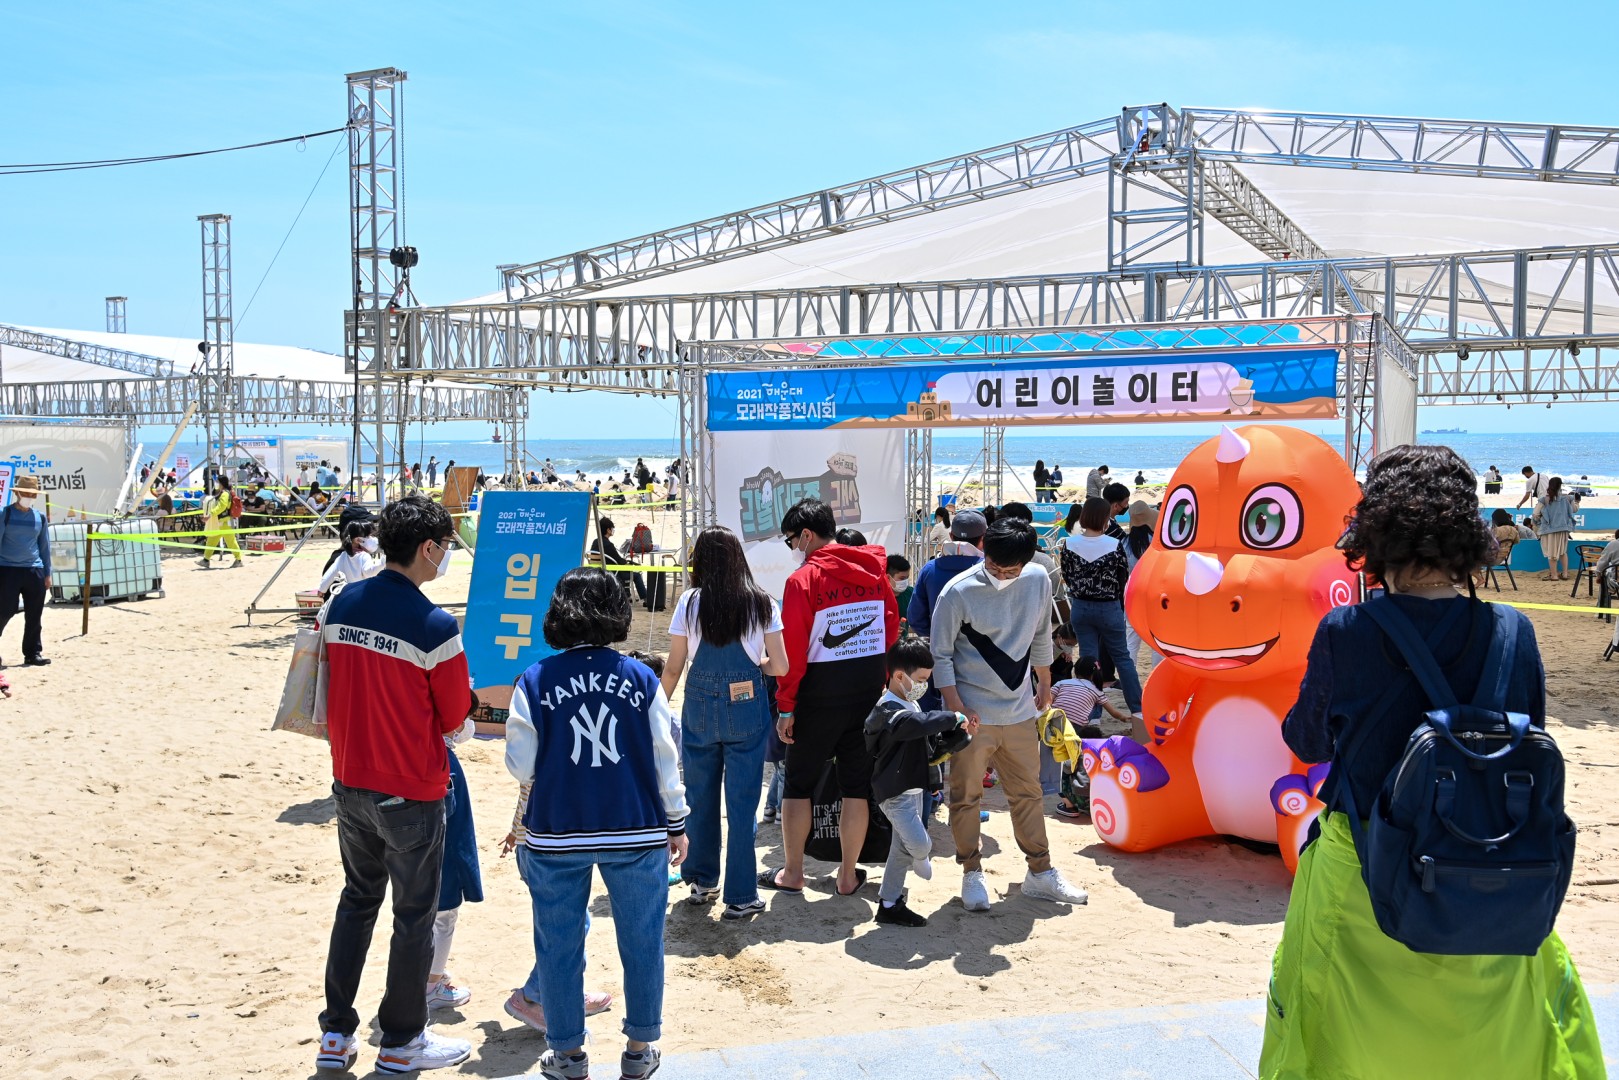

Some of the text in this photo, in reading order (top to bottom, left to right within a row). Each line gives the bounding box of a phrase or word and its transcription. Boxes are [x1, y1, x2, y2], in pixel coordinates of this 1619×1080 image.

[737, 381, 803, 401] 2021 해운대
[736, 393, 836, 420] 모래작품전시회
[10, 454, 52, 473] 해운대
[498, 508, 546, 521] 2021 해운대
[495, 518, 568, 535] 모래작품전시회
[494, 553, 541, 660] 입구
[827, 617, 853, 625] Goddess
[338, 627, 399, 654] SINCE 1941
[835, 648, 858, 657] crafted
[540, 672, 645, 711] YANKEES
[813, 804, 829, 817] IT'S
